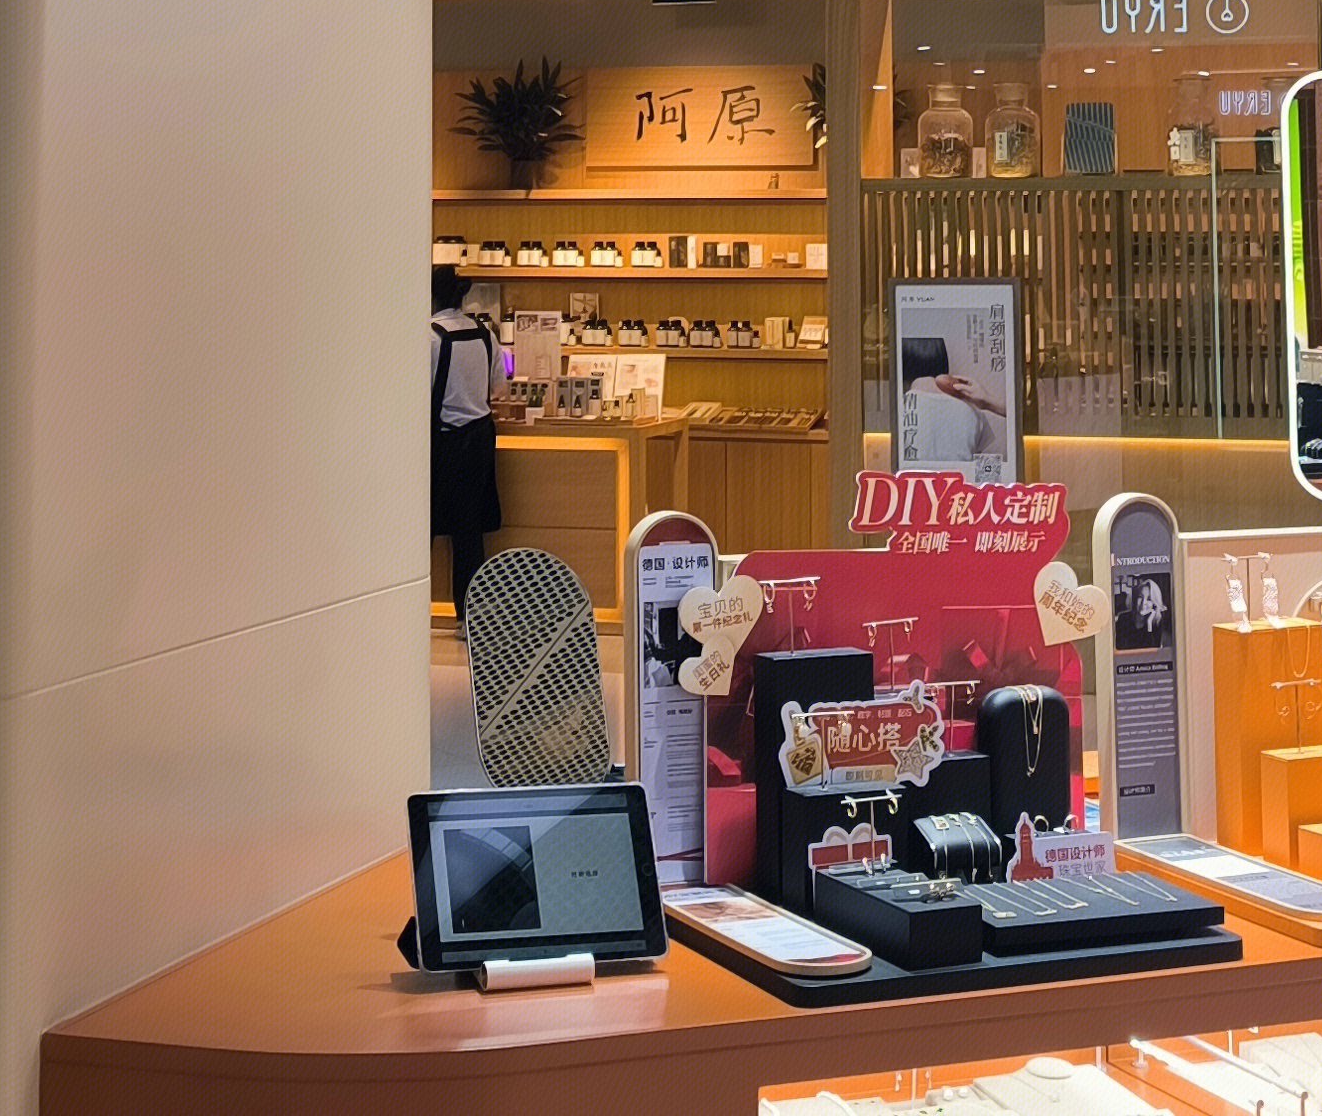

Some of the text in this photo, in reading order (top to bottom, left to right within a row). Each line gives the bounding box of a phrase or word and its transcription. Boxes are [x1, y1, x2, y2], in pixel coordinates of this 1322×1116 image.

[635, 84, 776, 146] 阿原
[896, 529, 1046, 554] 全国唯一 即刻展示
[697, 597, 744, 620] 宝贝的
[1038, 591, 1090, 633] 周年纪念
[1045, 844, 1106, 863] 德国设计师
